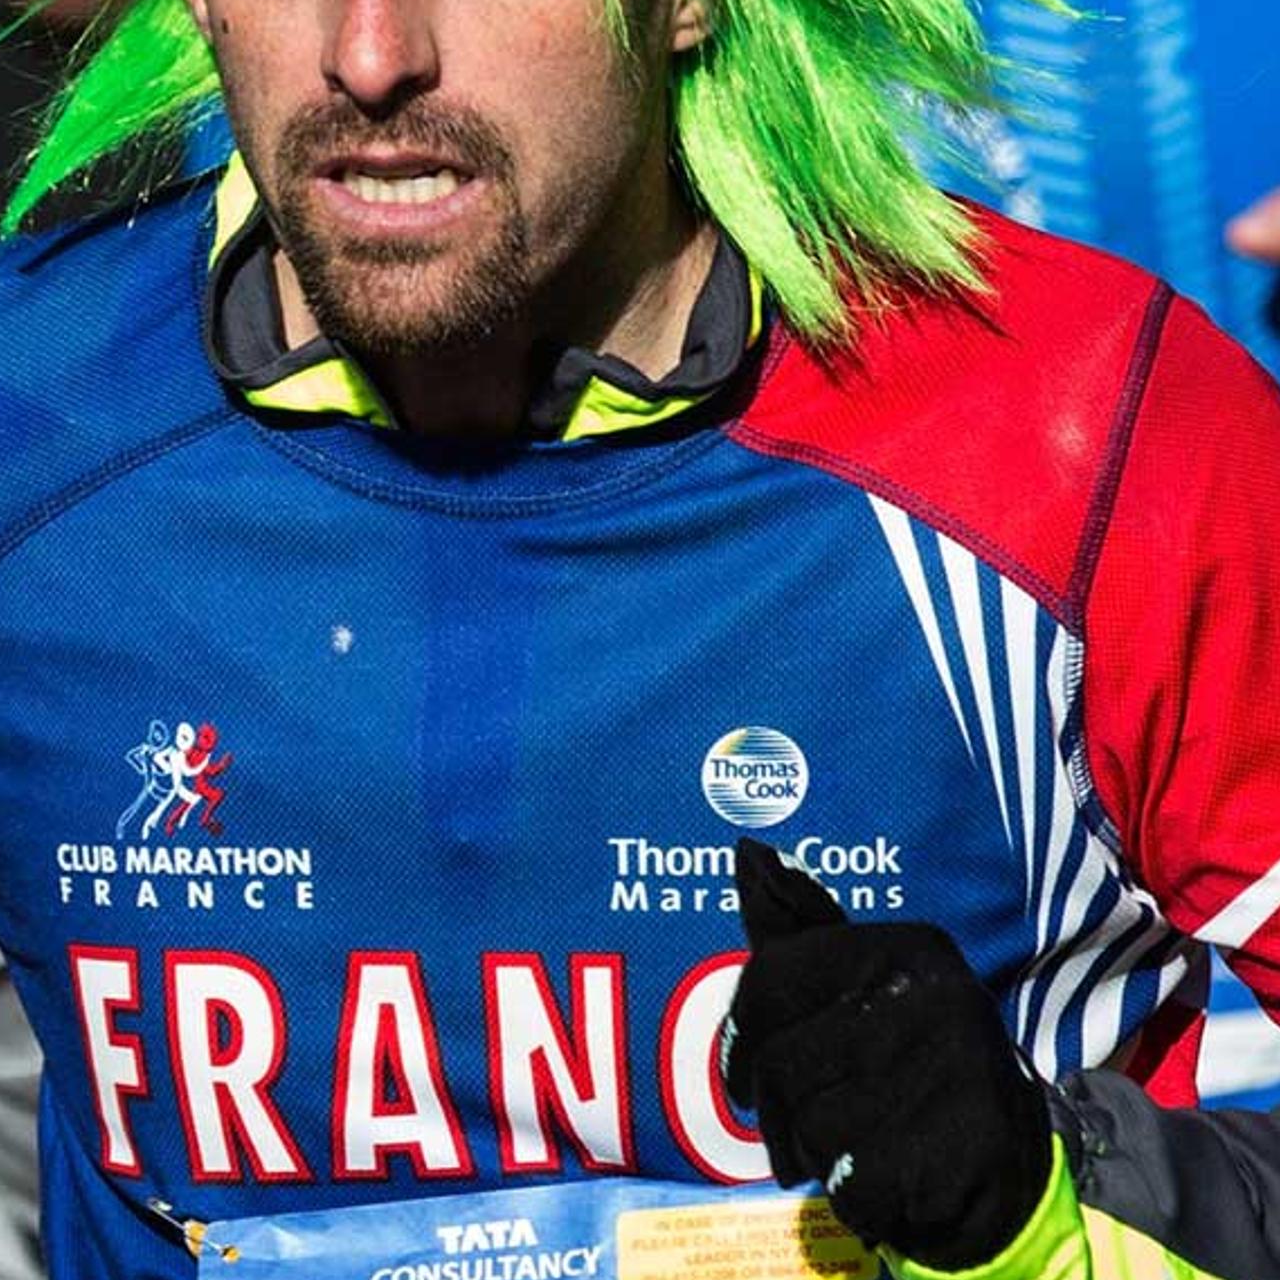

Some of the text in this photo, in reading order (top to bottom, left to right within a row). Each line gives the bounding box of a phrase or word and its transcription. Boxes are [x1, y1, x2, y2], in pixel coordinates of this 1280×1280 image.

[710, 758, 800, 779] Thomas
[744, 780, 800, 799] Cook
[57, 843, 312, 876] CLUB MARATHON
[608, 836, 903, 877] Thom Cook
[59, 876, 315, 910] FRANCE
[609, 881, 905, 912] Marans
[68, 941, 774, 1184] FRANC
[437, 1218, 540, 1255] TATA
